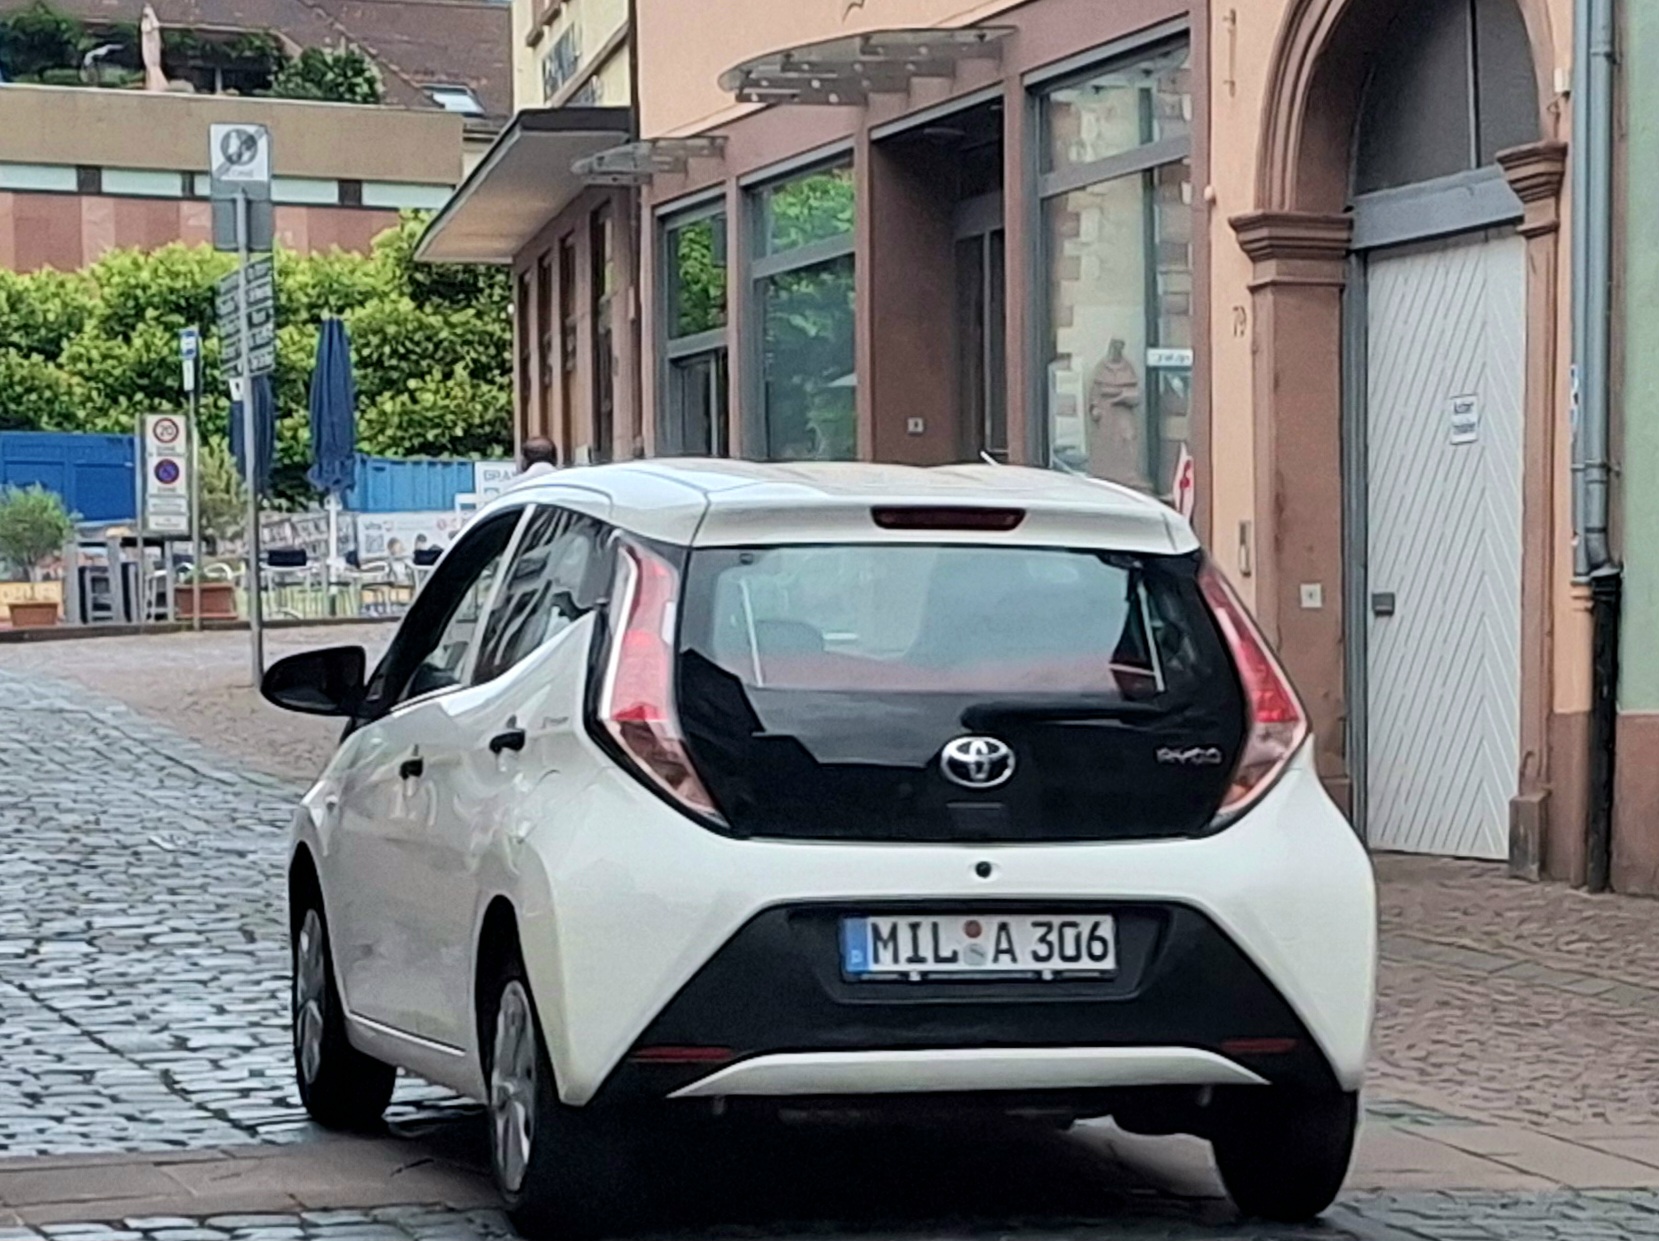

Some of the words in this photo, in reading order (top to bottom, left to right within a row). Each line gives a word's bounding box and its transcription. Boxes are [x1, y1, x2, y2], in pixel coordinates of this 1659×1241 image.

[160, 424, 174, 436] 20
[871, 921, 959, 964] MIL
[992, 921, 1018, 964] A
[1031, 920, 1109, 963] 306
